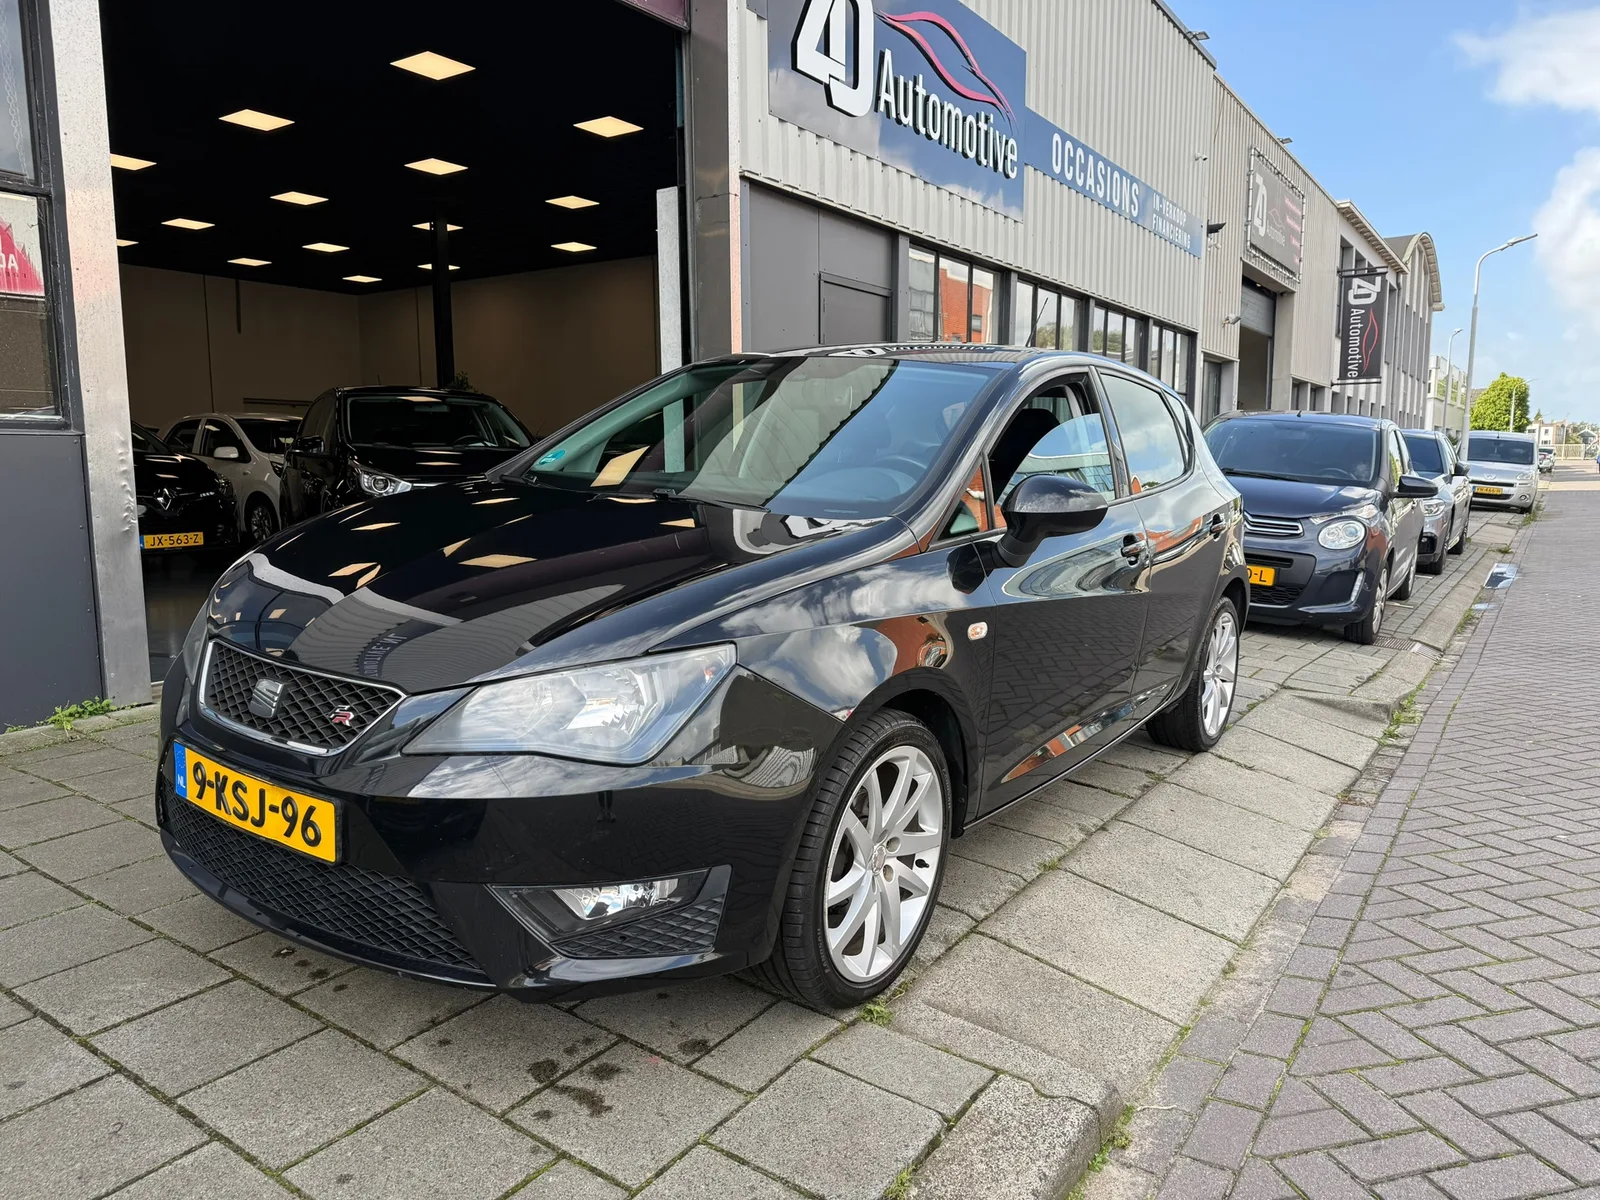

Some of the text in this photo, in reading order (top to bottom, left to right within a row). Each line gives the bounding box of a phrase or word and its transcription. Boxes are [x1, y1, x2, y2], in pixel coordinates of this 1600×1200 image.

[877, 47, 1018, 180] Automotive
[1052, 132, 1139, 218] OCCASIONS
[1152, 213, 1191, 249] FINANCIERING
[1153, 192, 1187, 227] IN-VERKOOP
[1347, 308, 1366, 378] Automotive
[150, 534, 199, 547] JX-563-Z
[177, 773, 186, 789] NL
[192, 761, 322, 848] 9-KSJ-96
